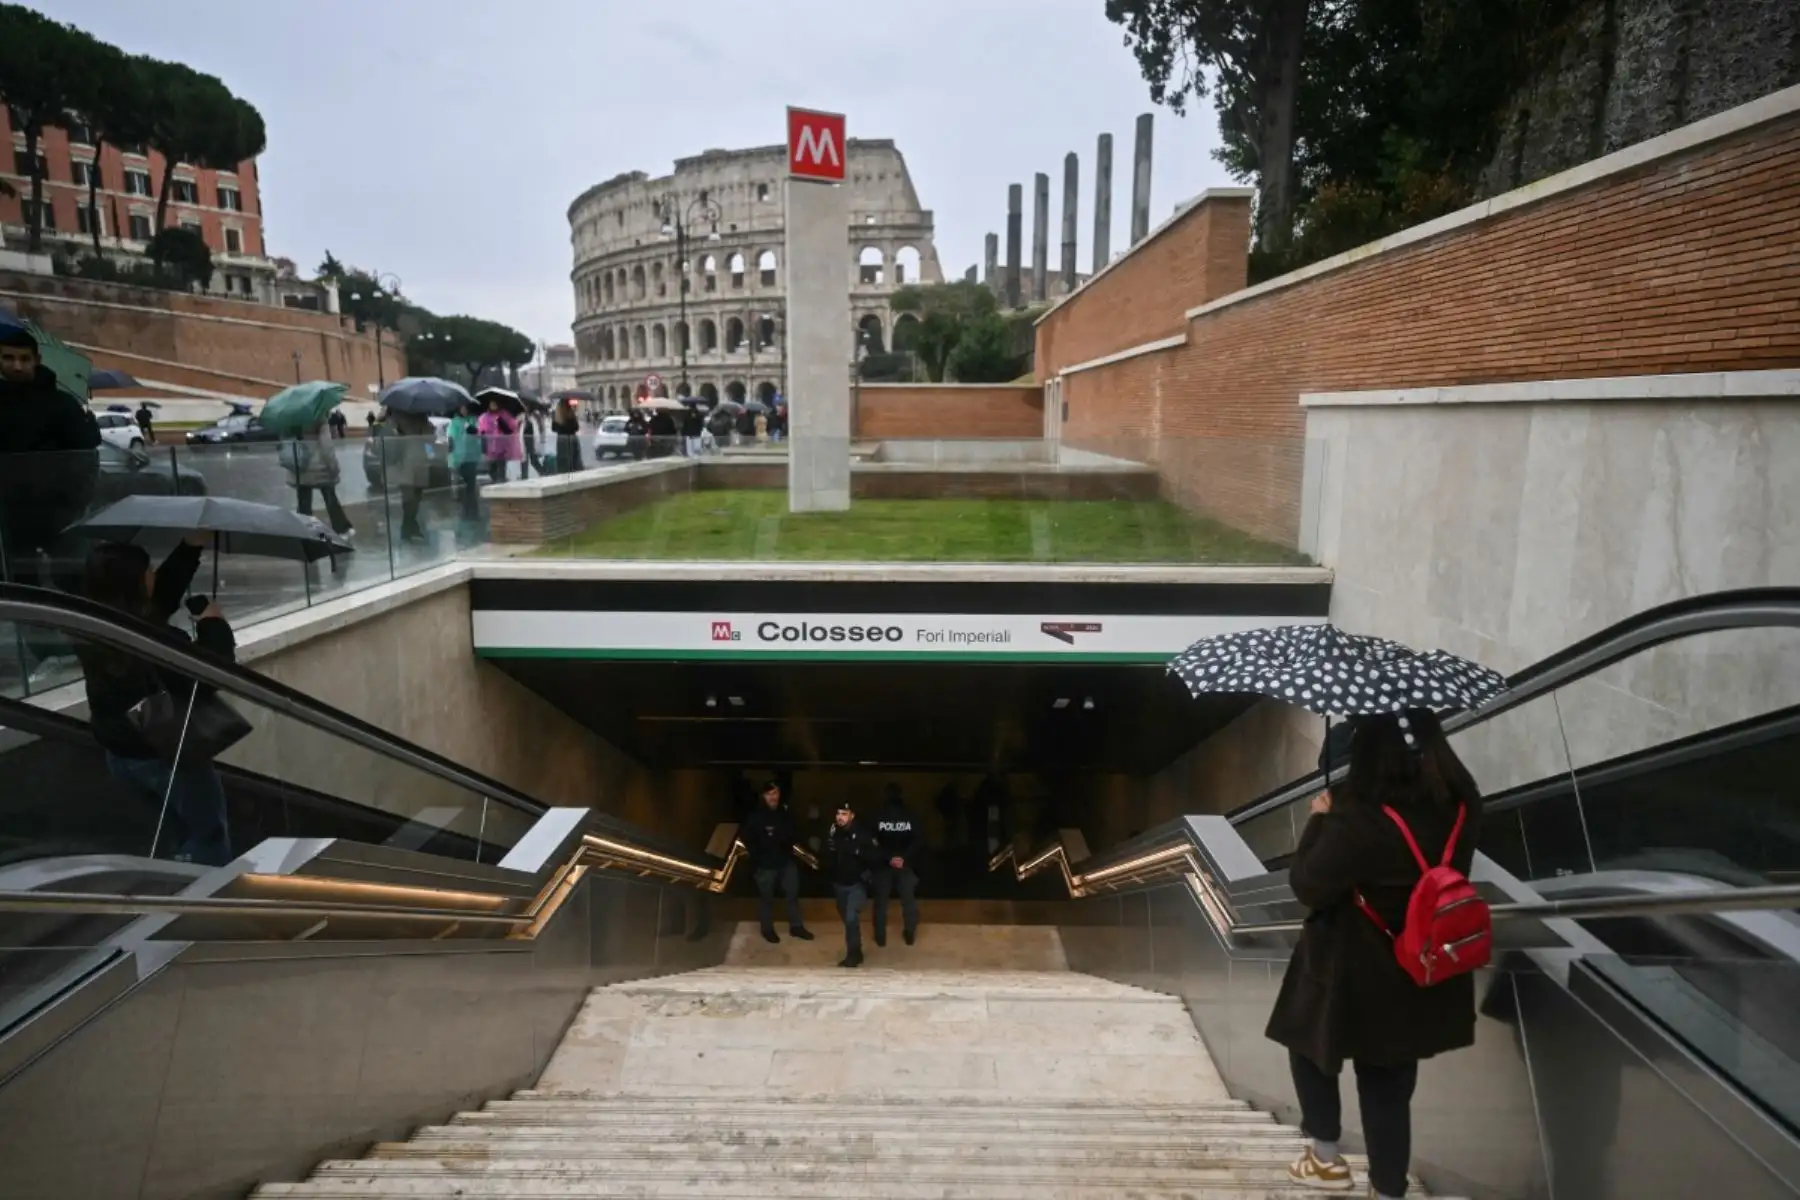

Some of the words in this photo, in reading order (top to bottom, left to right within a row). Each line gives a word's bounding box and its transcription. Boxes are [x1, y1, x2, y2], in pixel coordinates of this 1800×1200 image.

[795, 125, 840, 167] M
[757, 621, 903, 642] Colosseo
[916, 629, 944, 642] Fori
[948, 629, 1011, 645] Imperiali
[879, 821, 912, 831] POLIZIA
